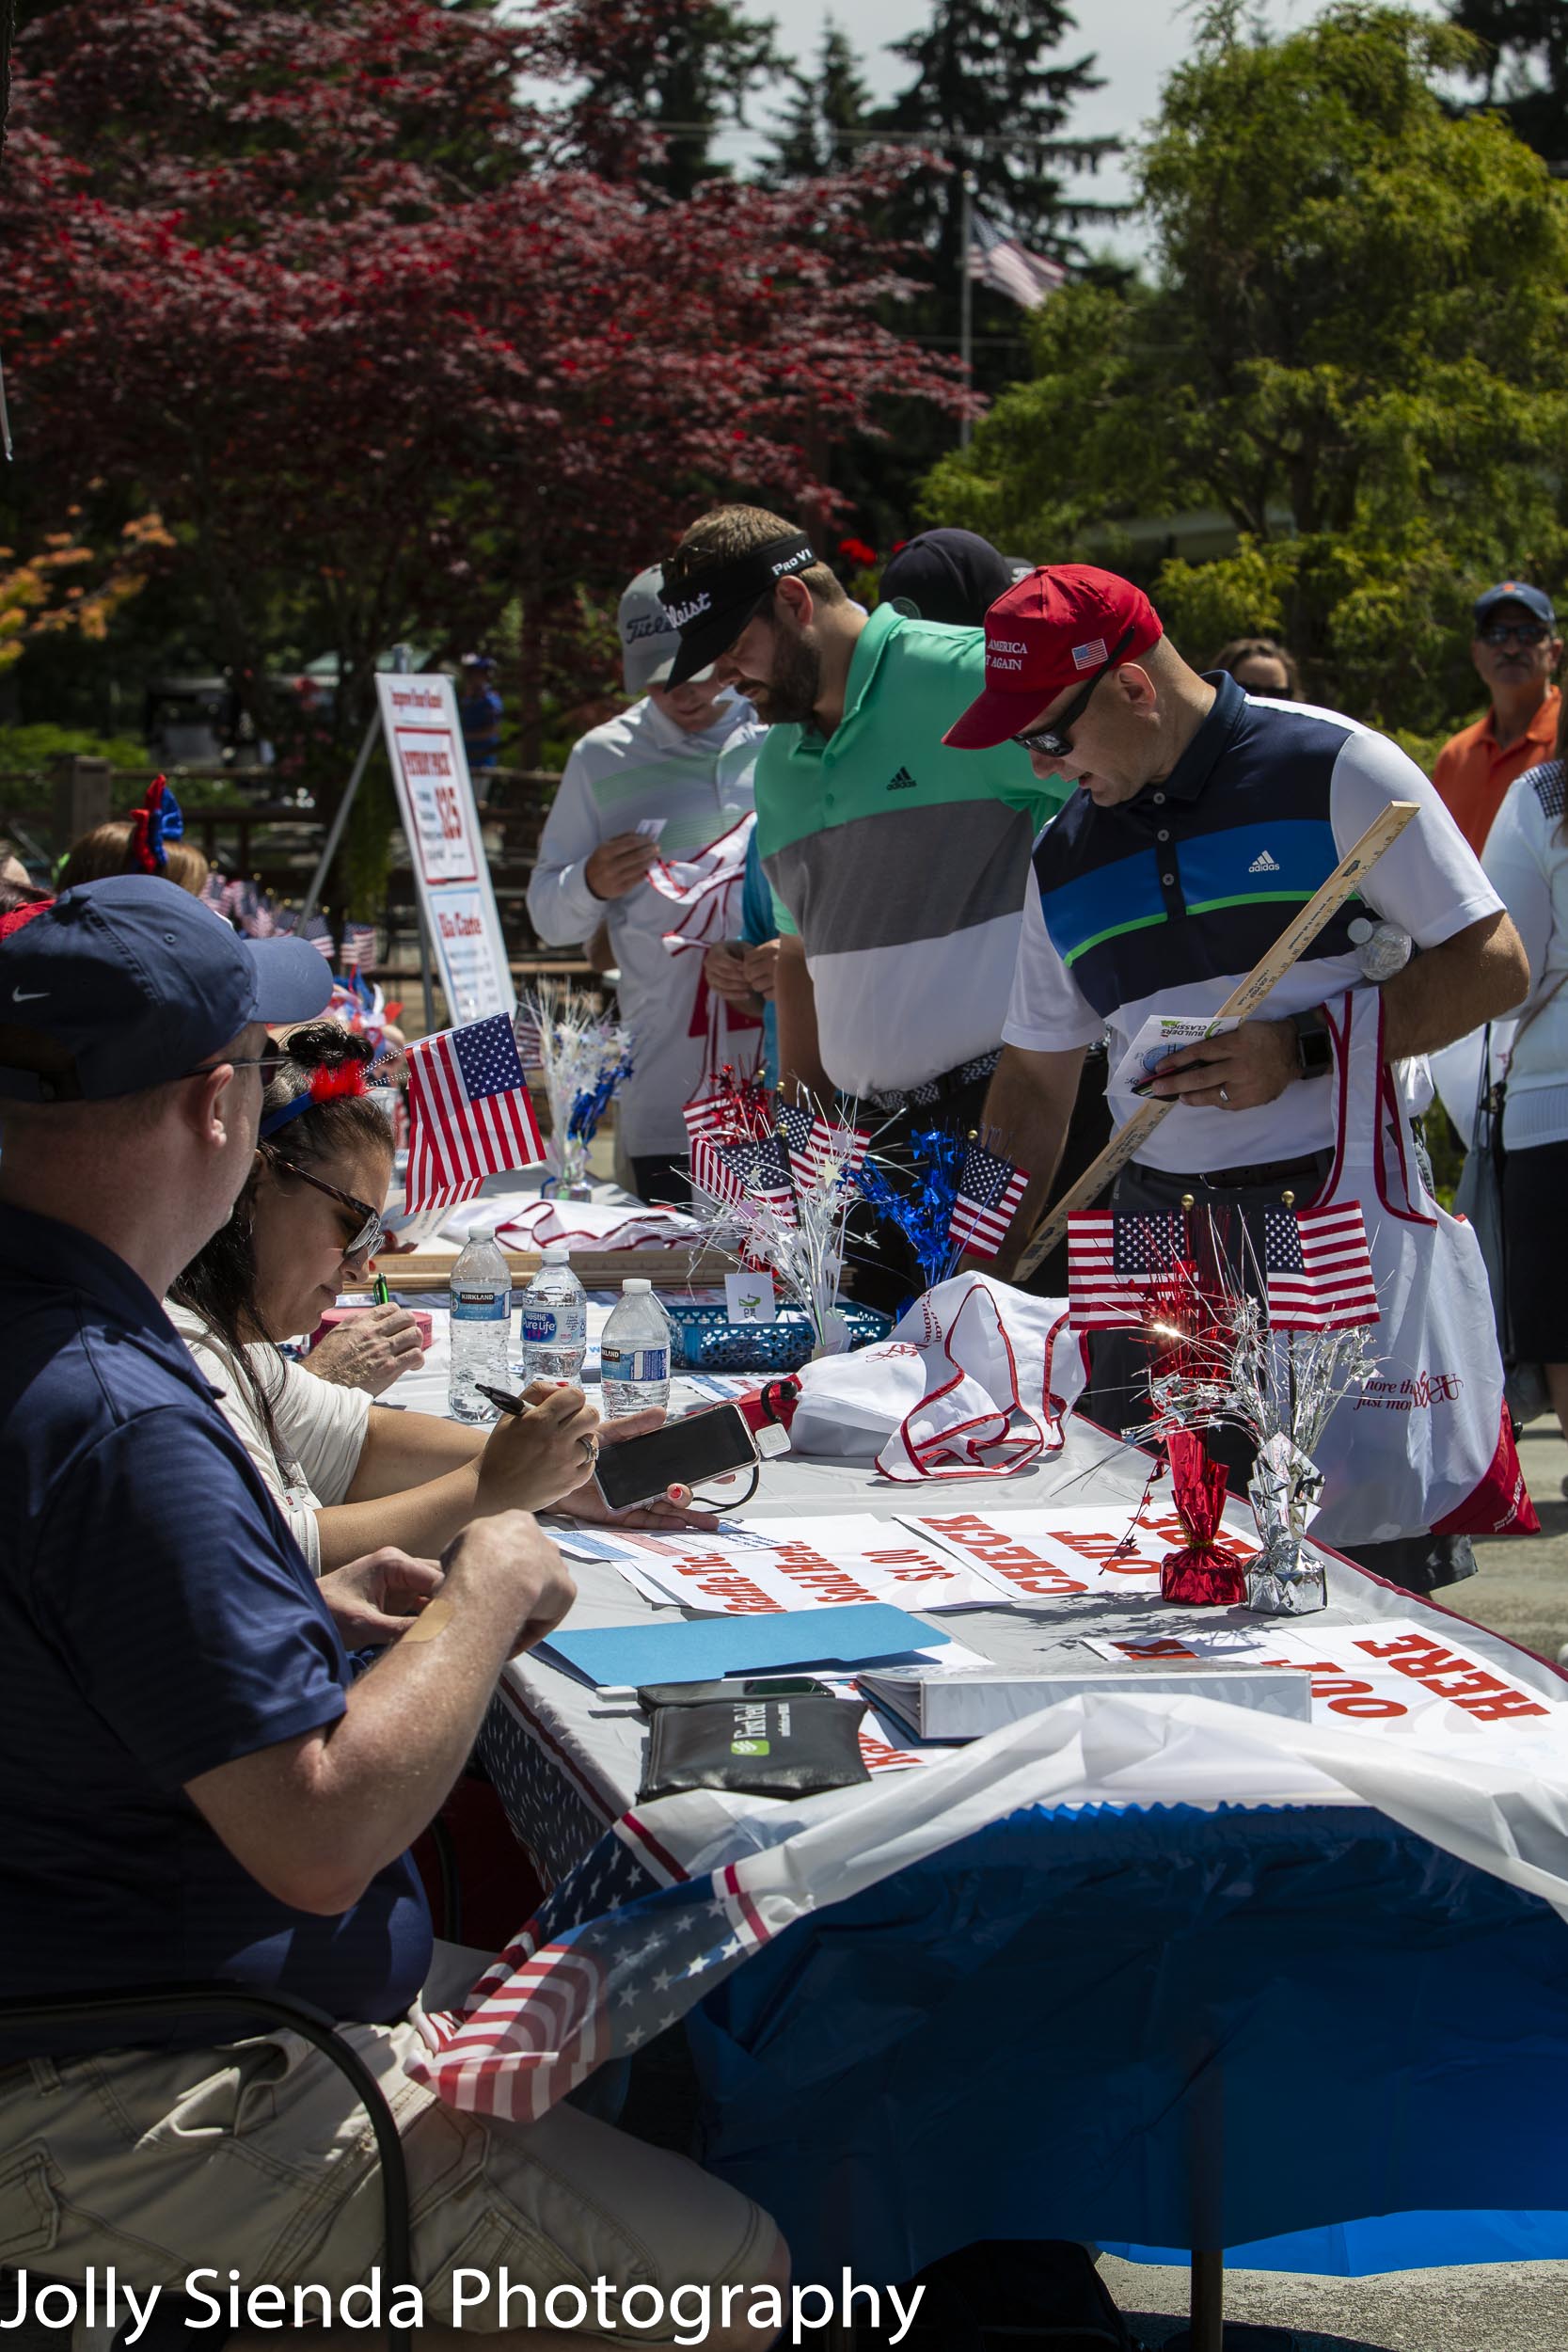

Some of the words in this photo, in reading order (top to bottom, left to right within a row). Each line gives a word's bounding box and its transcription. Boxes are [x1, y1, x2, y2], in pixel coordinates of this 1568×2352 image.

[988, 639, 1028, 654] AMERICA
[991, 658, 1022, 670] AGAIN
[886, 779, 916, 791] adidas
[1248, 863, 1280, 874] adidas
[523, 1318, 538, 1329] Pure
[539, 1322, 555, 1334] Life
[861, 1549, 961, 1581] $1.00
[918, 1514, 1089, 1594] CHECK
[1046, 1531, 1163, 1574] OUT
[696, 1576, 789, 1613] Raffle
[789, 1573, 880, 1603] Sold
[1352, 1634, 1551, 1721] HERE
